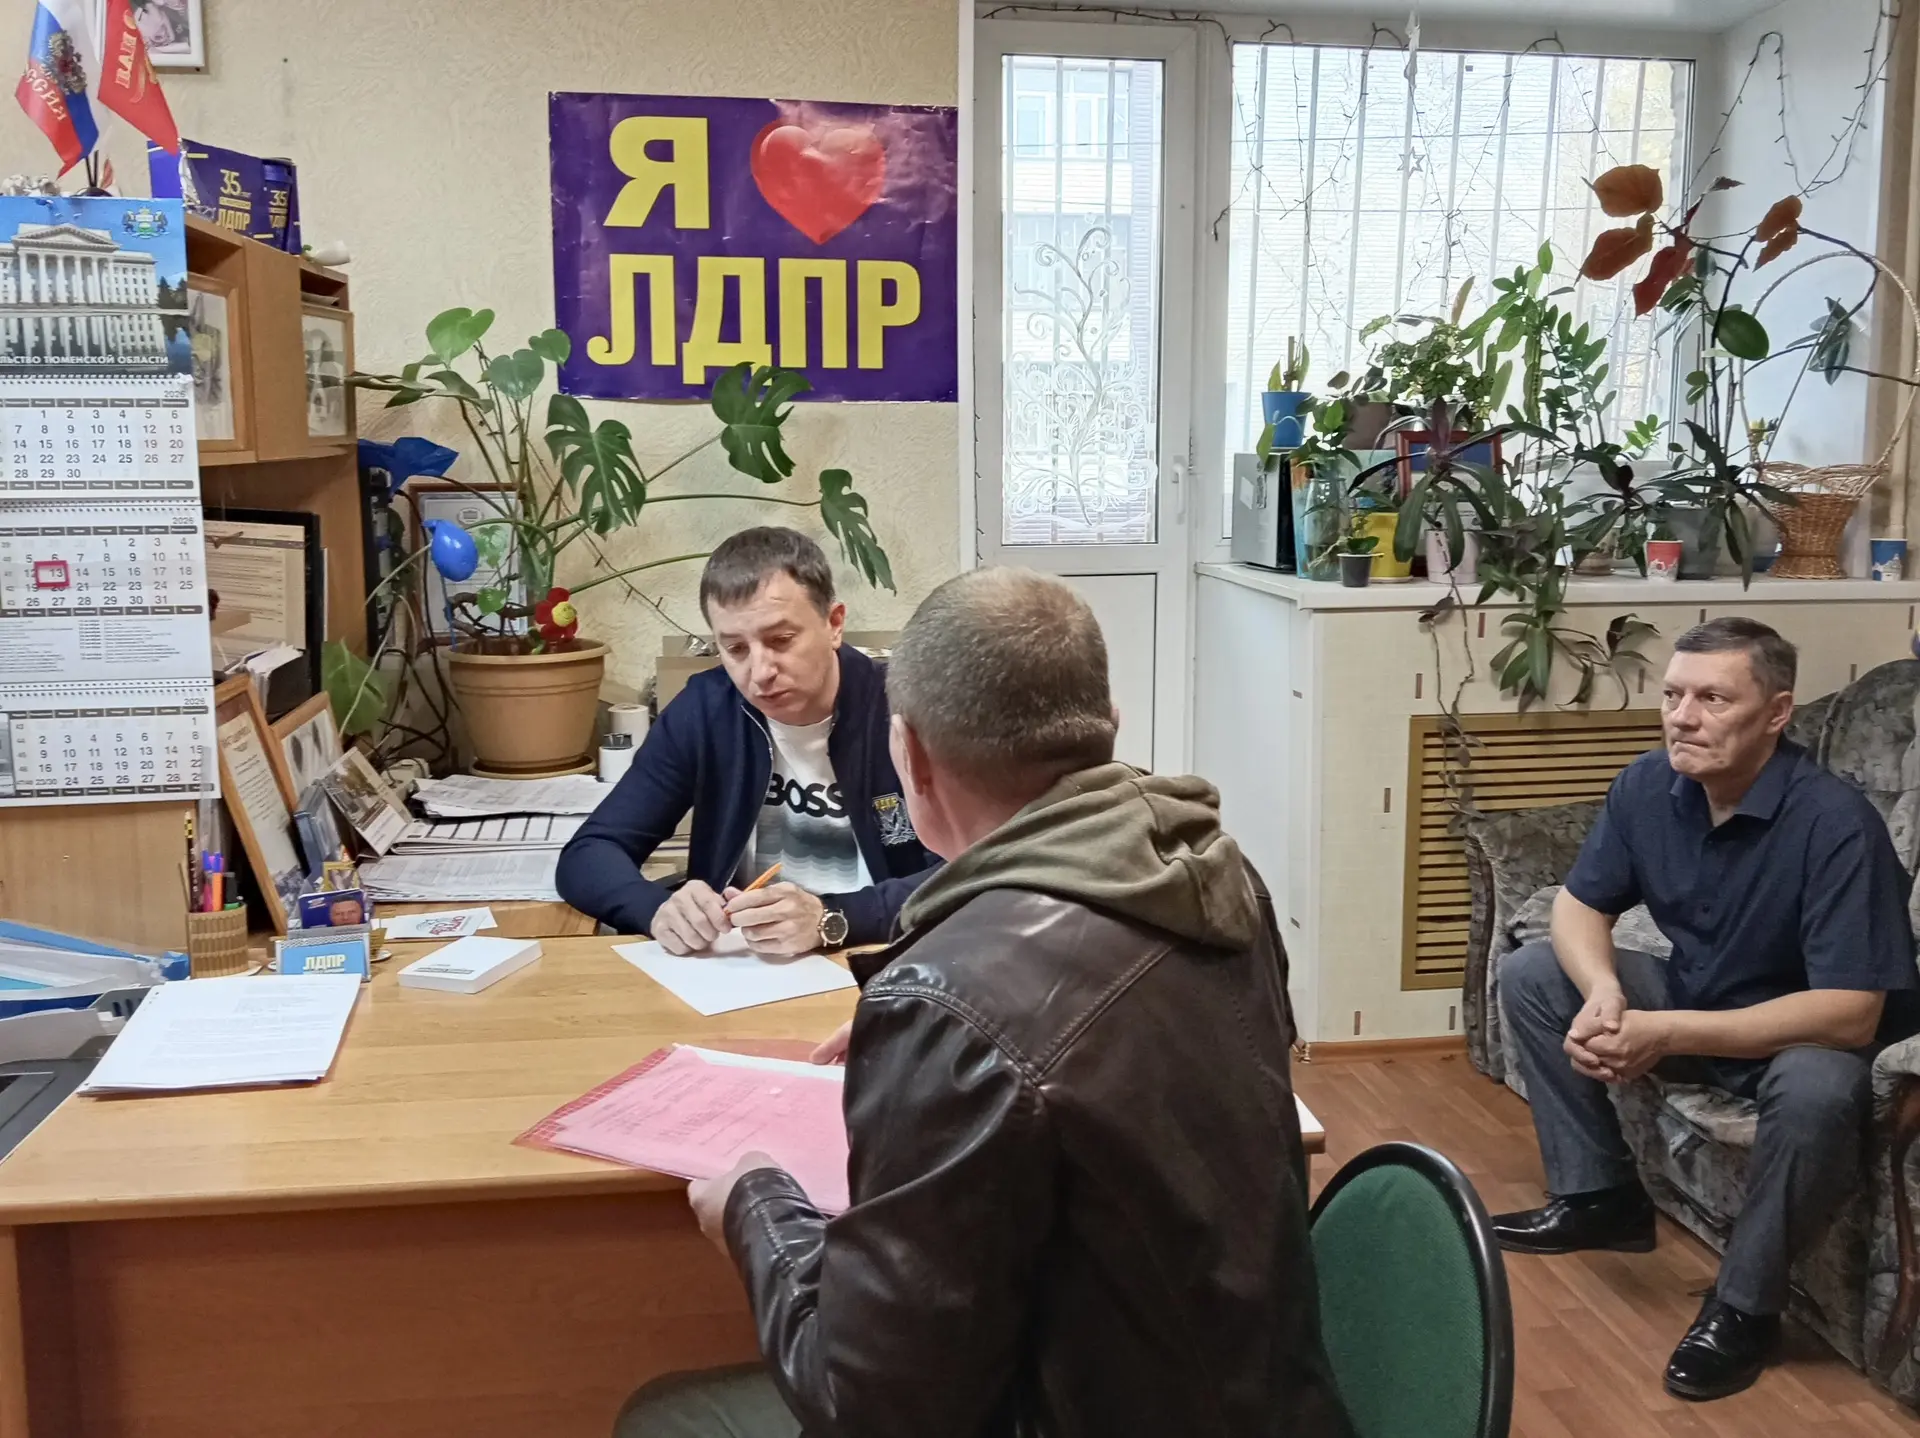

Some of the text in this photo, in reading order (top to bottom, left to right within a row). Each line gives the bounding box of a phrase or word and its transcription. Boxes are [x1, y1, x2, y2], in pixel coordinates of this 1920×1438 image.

[603, 116, 710, 229] Я
[220, 169, 242, 197] 35
[269, 190, 288, 206] 35
[216, 208, 250, 231] ЛДПР
[586, 253, 921, 385] ЛДПР
[44, 354, 114, 364] ТЮМЕНСКОЙ
[117, 356, 168, 364] ОБЛАСТИ
[41, 409, 178, 419] 1 2 3 4 5 6
[15, 424, 183, 434] 7 8 9 10 11 12 13
[13, 439, 184, 449] 14 15 16 17 18 19 20
[14, 454, 184, 464] 21 22 23 24 25 26 27
[14, 469, 81, 478] 28 29 30
[102, 539, 108, 547] 1
[128, 538, 136, 547] 2
[154, 538, 161, 547] 3
[180, 537, 187, 546] 4
[26, 554, 32, 563] 5
[77, 553, 84, 562] 7
[103, 553, 111, 562] 8
[129, 553, 137, 562] 9
[152, 552, 166, 562] 10
[178, 552, 190, 561] 11
[50, 569, 64, 578] 13
[75, 568, 90, 577] 14
[101, 568, 116, 577] 15
[128, 567, 141, 576] 16
[153, 567, 167, 576] 17
[179, 566, 193, 576] 18
[76, 582, 89, 592] 21
[102, 581, 117, 591] 22
[128, 581, 143, 591] 23
[153, 581, 168, 590] 24
[179, 581, 194, 590] 25
[25, 597, 40, 607] 26
[51, 597, 66, 606] 27
[77, 597, 92, 606] 28
[103, 596, 118, 605] 29
[129, 596, 143, 605] 30
[154, 595, 168, 605] 31
[192, 717, 197, 726] 1
[39, 735, 47, 745] 2
[64, 734, 72, 744] 3
[90, 734, 97, 743] 4
[116, 733, 123, 742] 5
[141, 732, 149, 742] 6
[165, 732, 173, 740] 7
[40, 750, 48, 759] 9
[62, 748, 77, 758] 10
[88, 748, 101, 757] 11
[113, 747, 128, 756] 12
[139, 746, 153, 756] 13
[164, 745, 178, 754] 14
[38, 763, 52, 773] 16
[64, 762, 77, 772] 17
[89, 762, 103, 771] 18
[115, 761, 129, 770] 19
[140, 760, 154, 769] 20
[165, 760, 178, 769] 21
[64, 777, 79, 786] 24
[90, 776, 105, 785] 25
[115, 775, 130, 784] 26
[141, 774, 156, 783] 27
[763, 773, 849, 818] BOSS
[302, 954, 346, 972] ЛДПР
